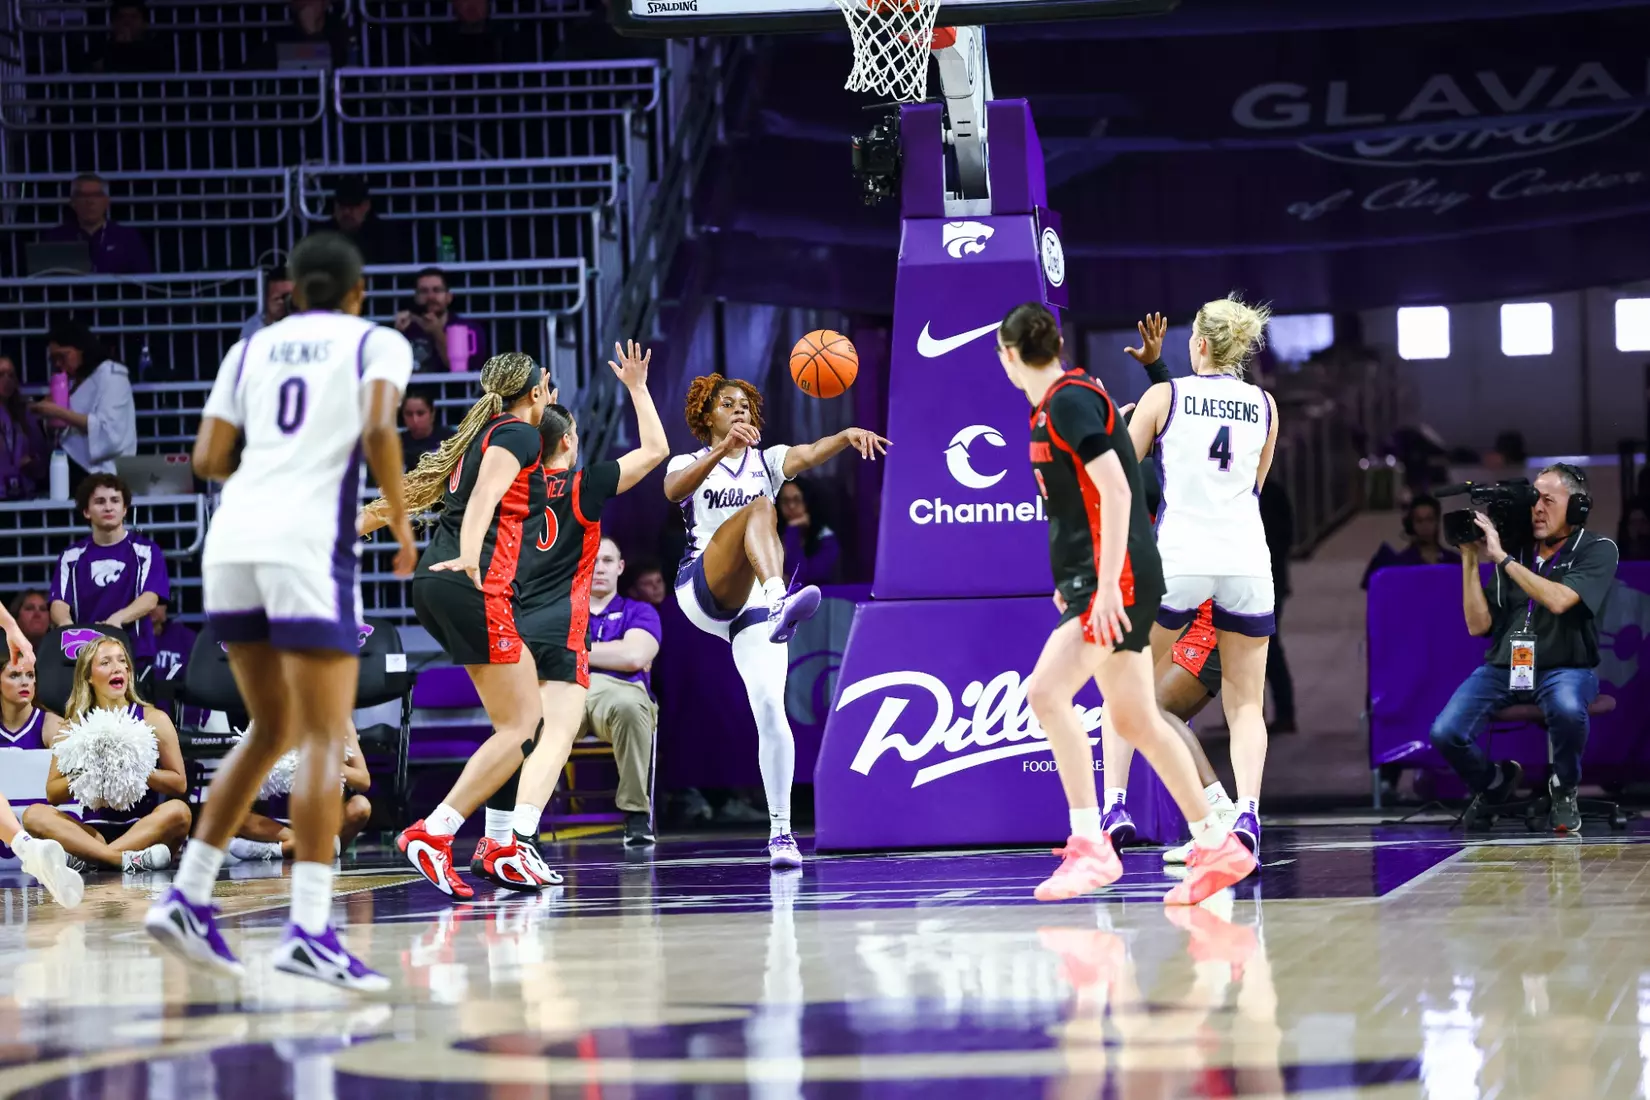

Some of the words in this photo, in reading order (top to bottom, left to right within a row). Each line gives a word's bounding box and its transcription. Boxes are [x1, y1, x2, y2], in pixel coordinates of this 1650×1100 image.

[647, 0, 698, 14] SPALDING
[1231, 57, 1650, 129] GLAVA
[1361, 178, 1471, 215] Clay
[277, 376, 306, 435] 0
[1184, 395, 1260, 424] CLAESSENS
[1208, 425, 1234, 472] 4
[1022, 760, 1058, 772] FOOD
